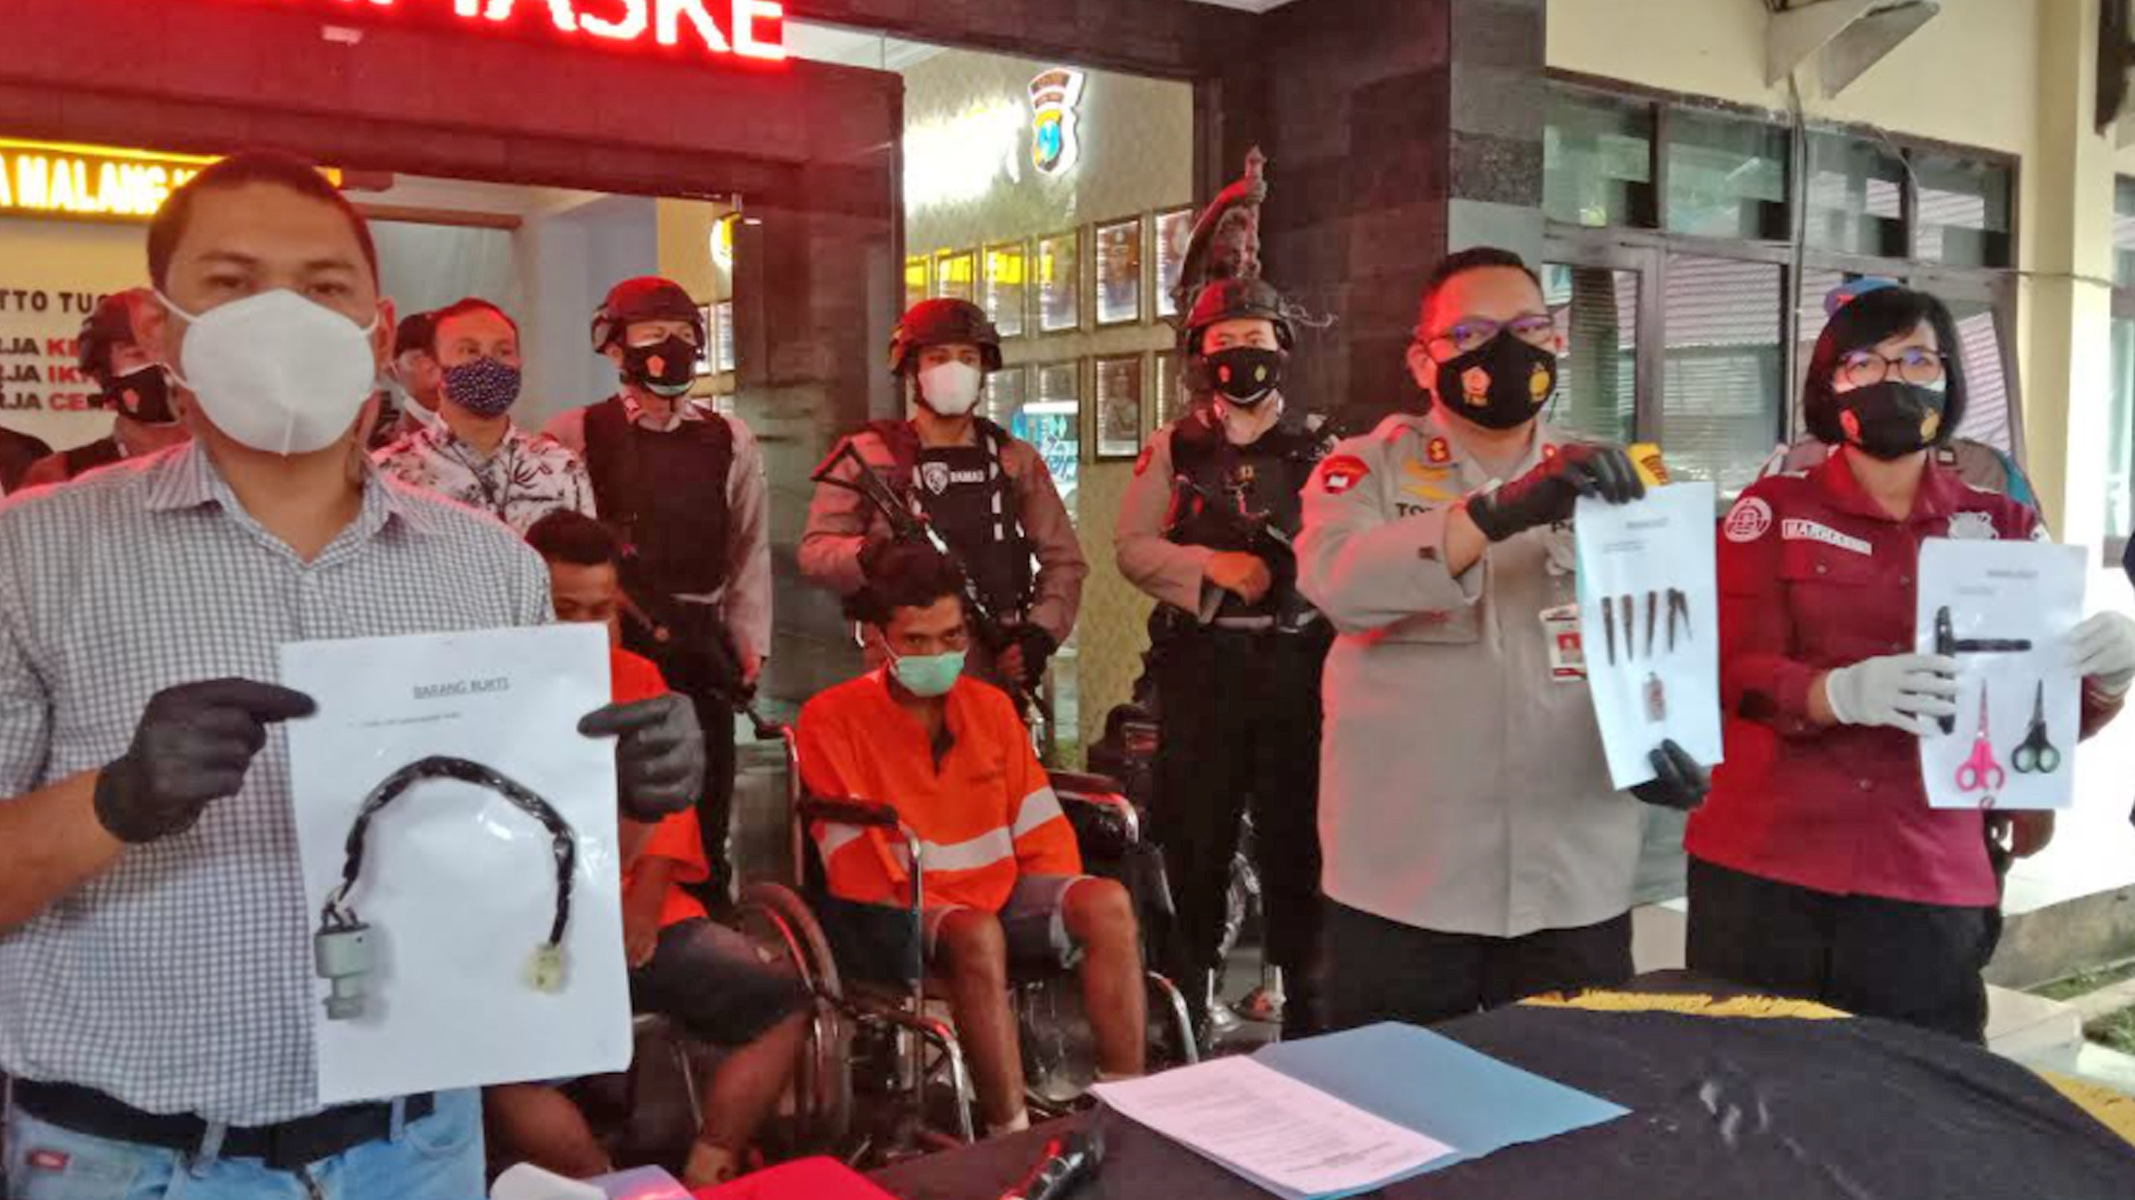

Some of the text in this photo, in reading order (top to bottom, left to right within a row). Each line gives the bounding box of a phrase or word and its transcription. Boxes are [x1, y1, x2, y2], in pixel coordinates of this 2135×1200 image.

[58, 291, 106, 313] TU
[0, 338, 40, 356] JA
[0, 365, 88, 384] JA IK
[0, 393, 104, 411] JA CE
[1395, 502, 1432, 518] TO
